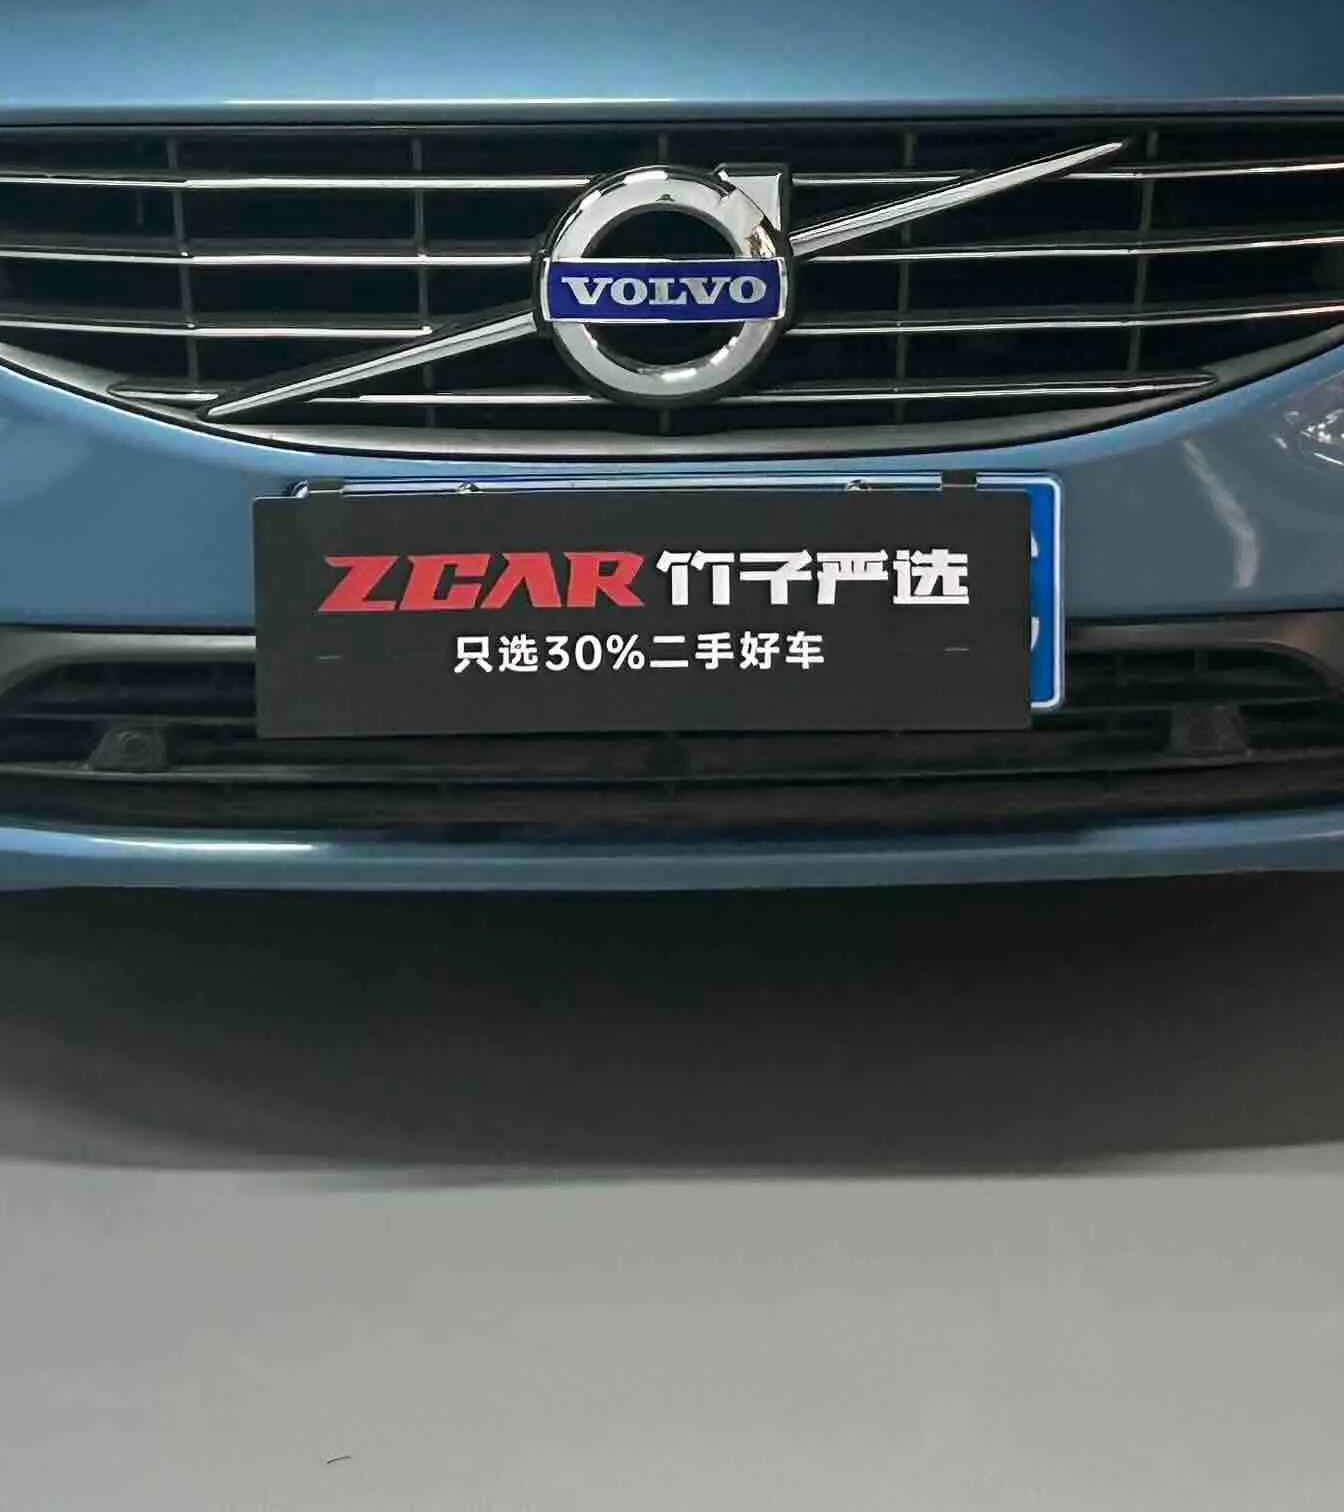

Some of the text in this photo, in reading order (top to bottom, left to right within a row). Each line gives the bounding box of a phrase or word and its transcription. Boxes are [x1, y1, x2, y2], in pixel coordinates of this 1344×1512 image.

[561, 274, 768, 306] VOLVO
[318, 552, 646, 613] ZCAR
[657, 549, 970, 606] 竹子严选
[453, 631, 825, 674] 只选30%二手好车
